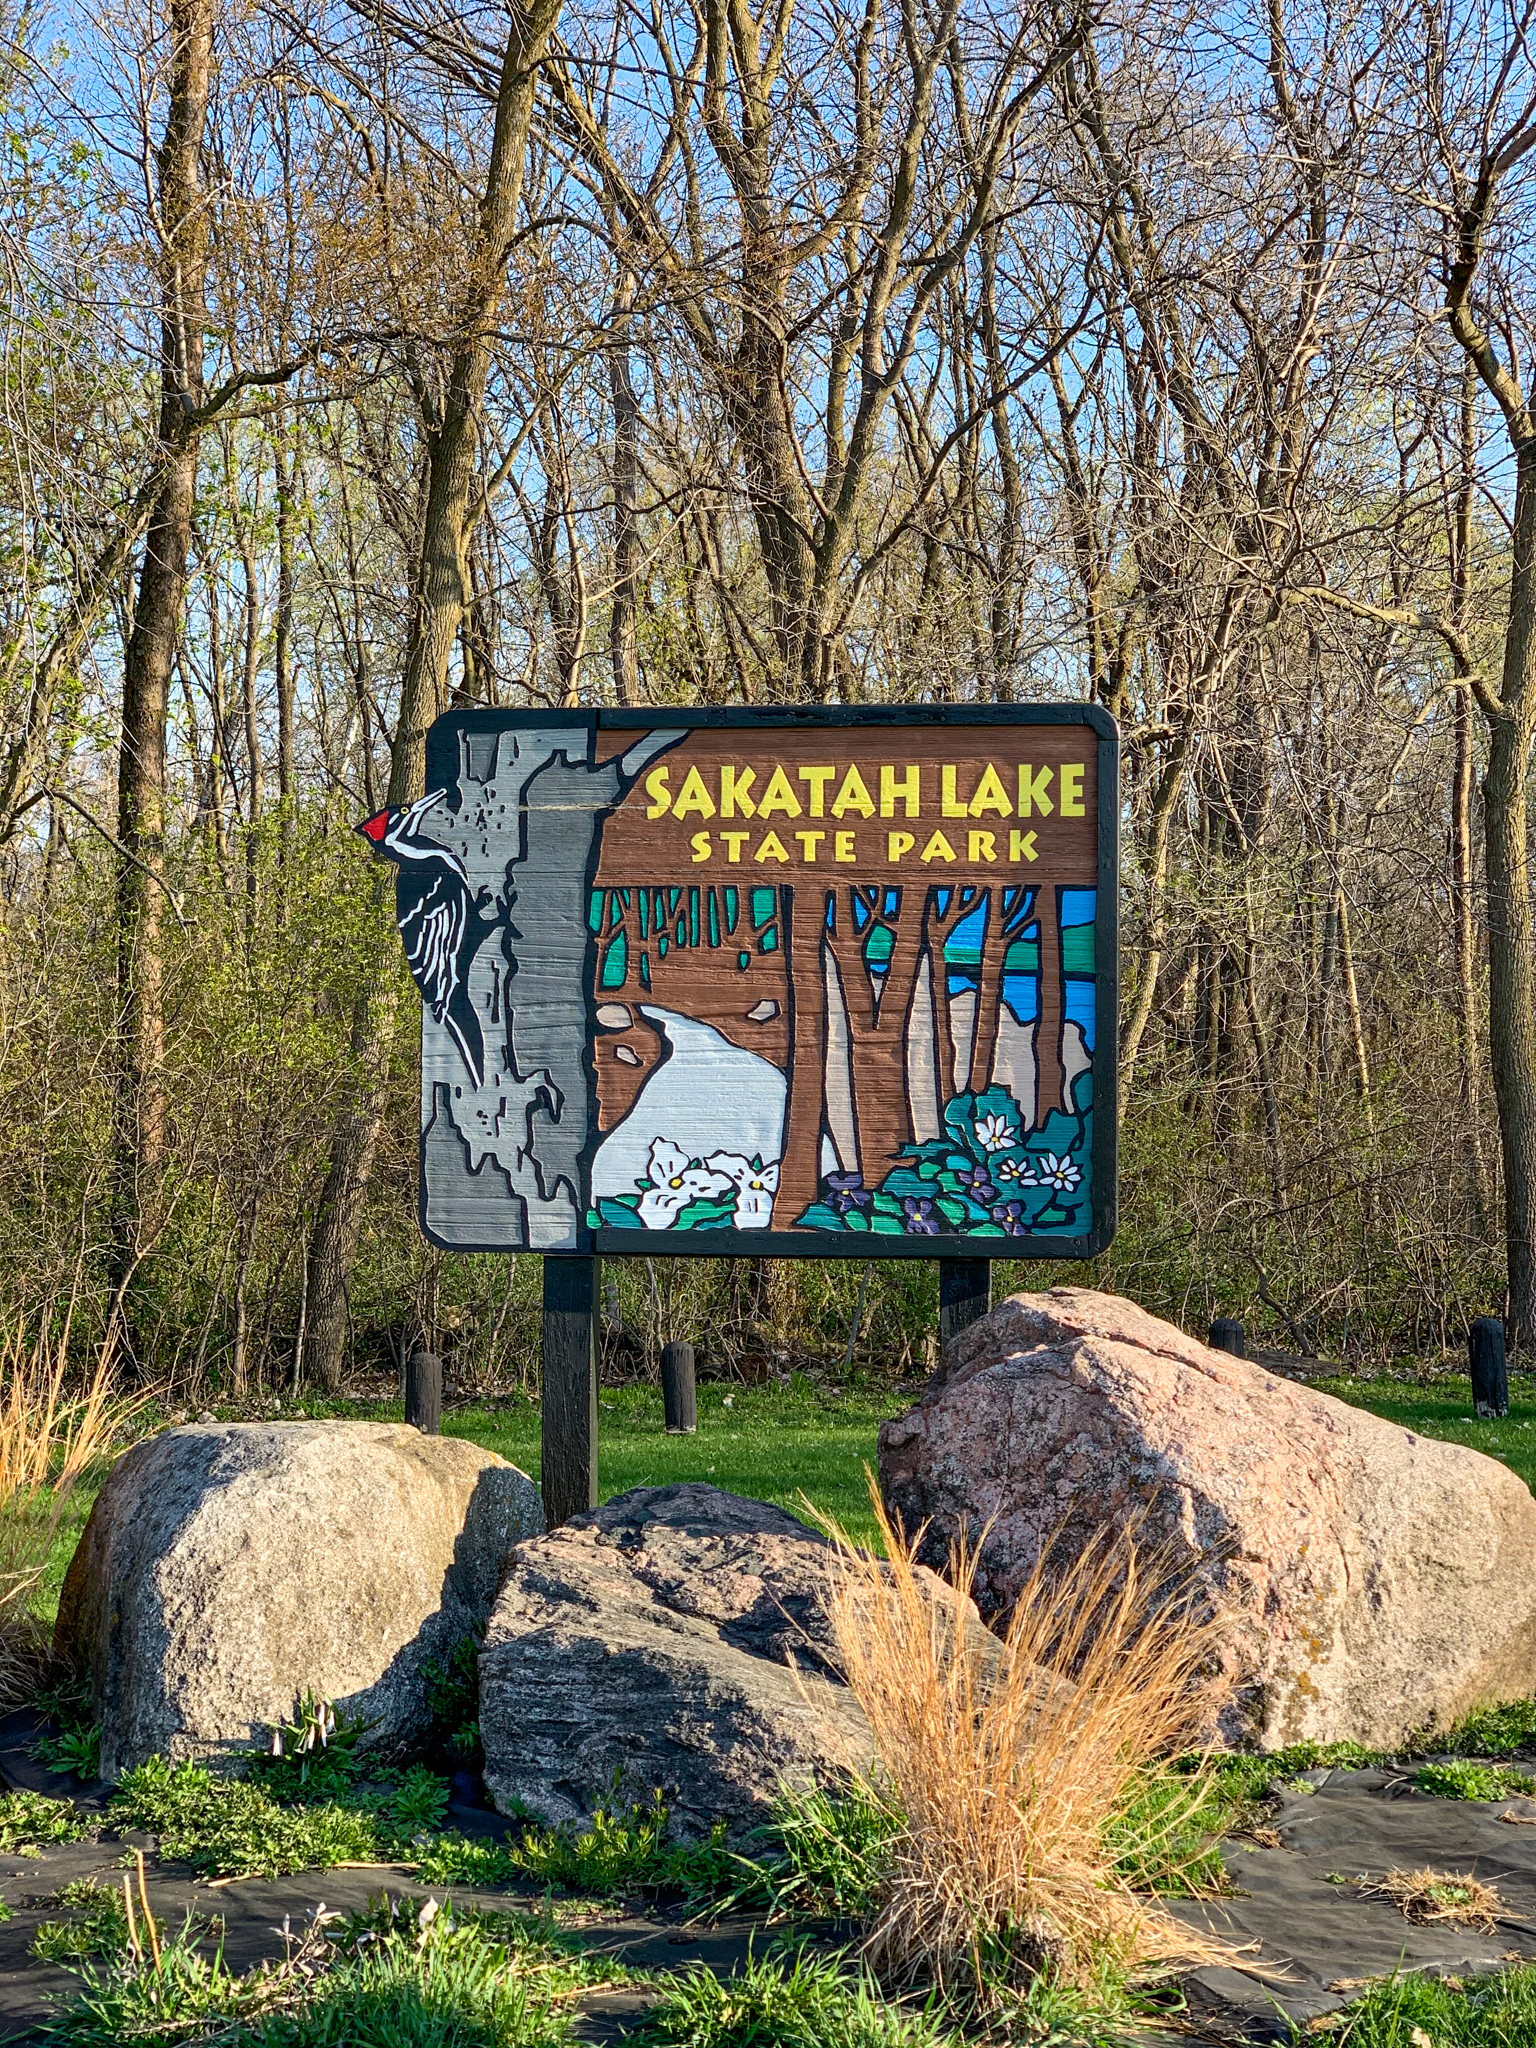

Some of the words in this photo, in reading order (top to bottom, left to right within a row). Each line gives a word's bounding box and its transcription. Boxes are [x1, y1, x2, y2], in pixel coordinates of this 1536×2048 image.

[646, 765, 920, 819] SAKATAH
[942, 764, 1085, 817] LAKE
[691, 831, 855, 862] STATE
[889, 830, 1038, 862] PARK
